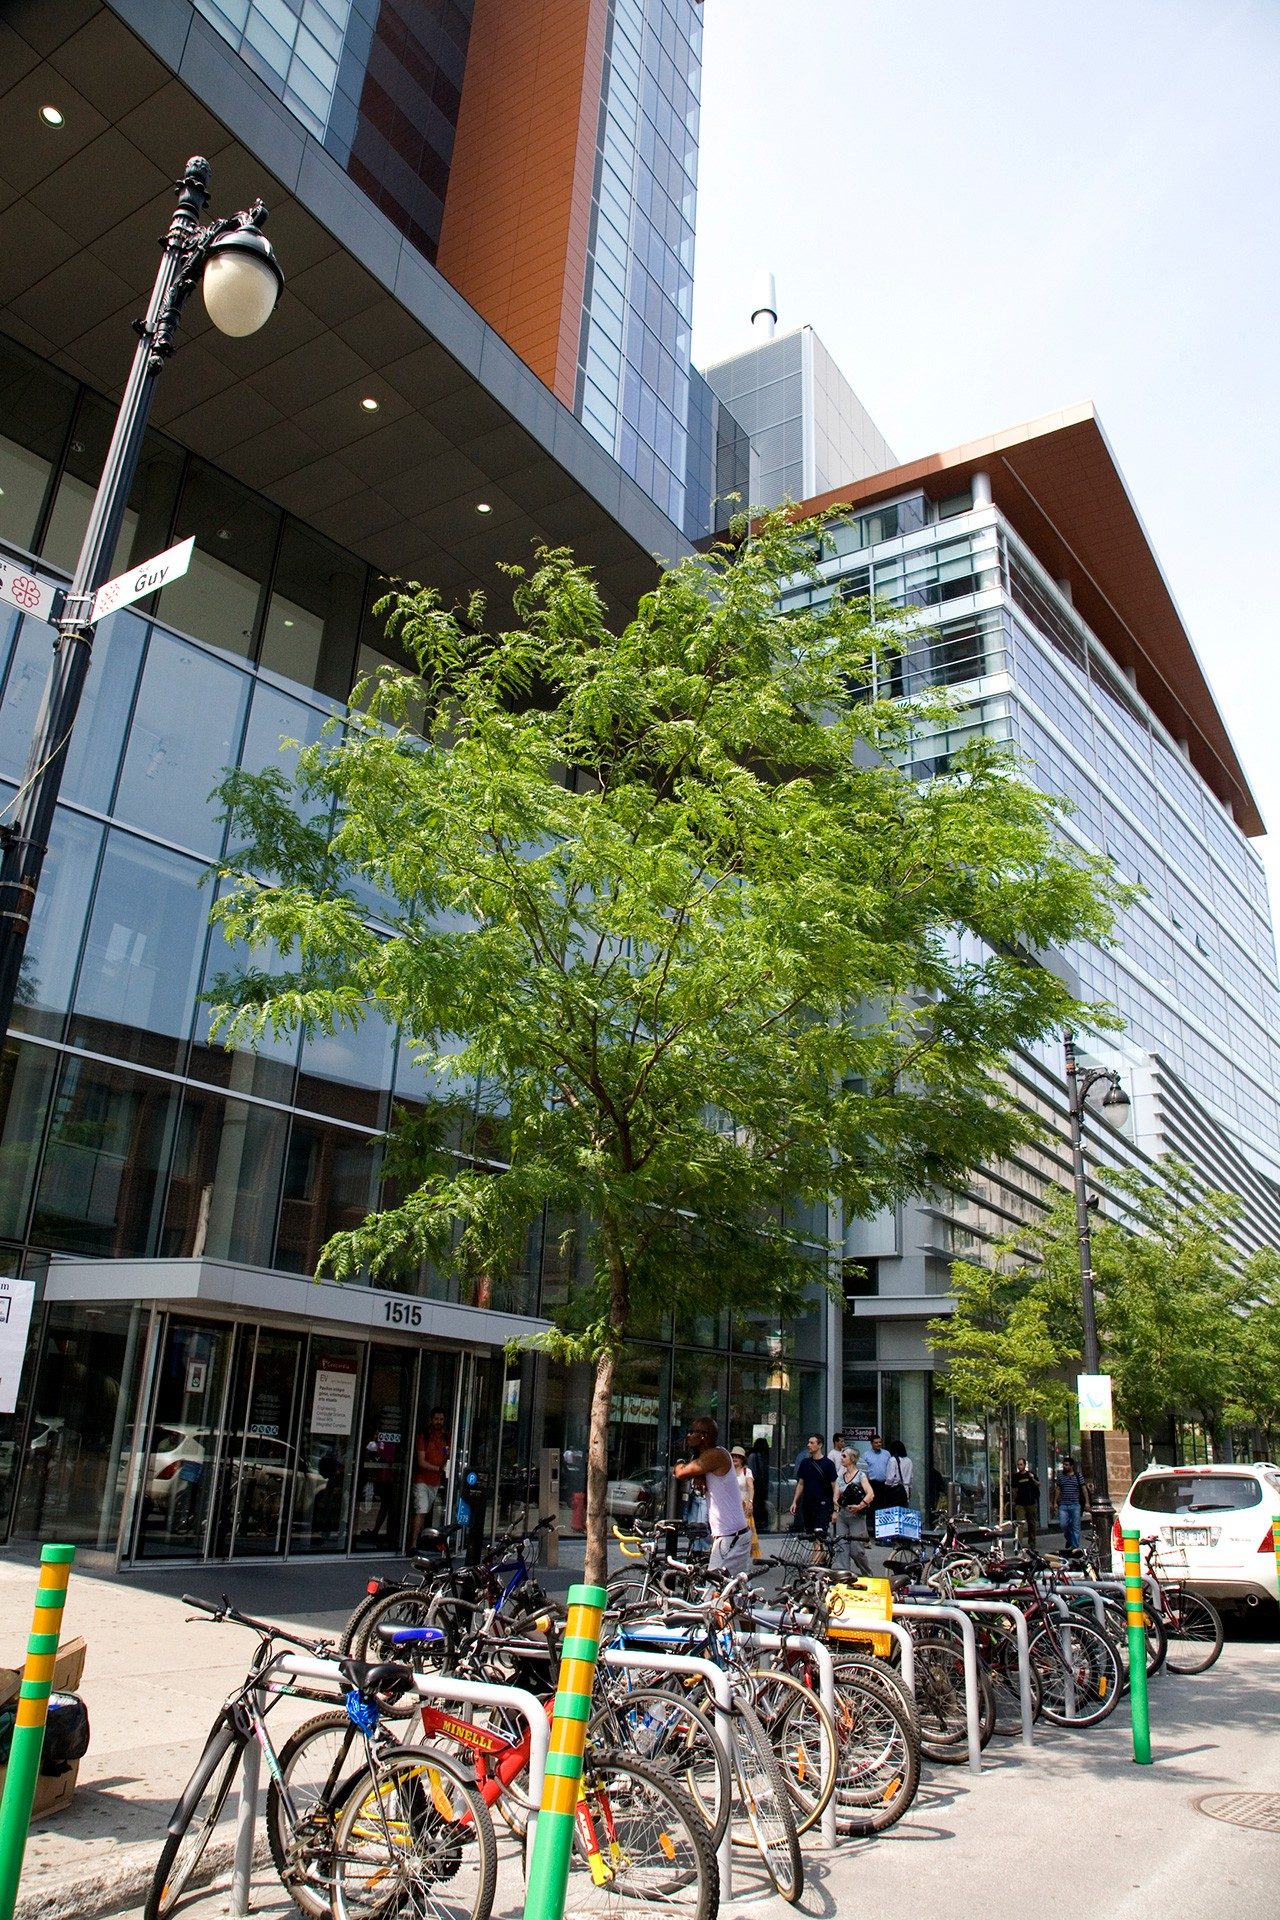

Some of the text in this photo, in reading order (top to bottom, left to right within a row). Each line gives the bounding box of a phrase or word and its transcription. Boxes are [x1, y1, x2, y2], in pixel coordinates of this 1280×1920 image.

[134, 566, 170, 593] Guy
[384, 1301, 422, 1326] 1515
[442, 1720, 493, 1750] MINELLI
